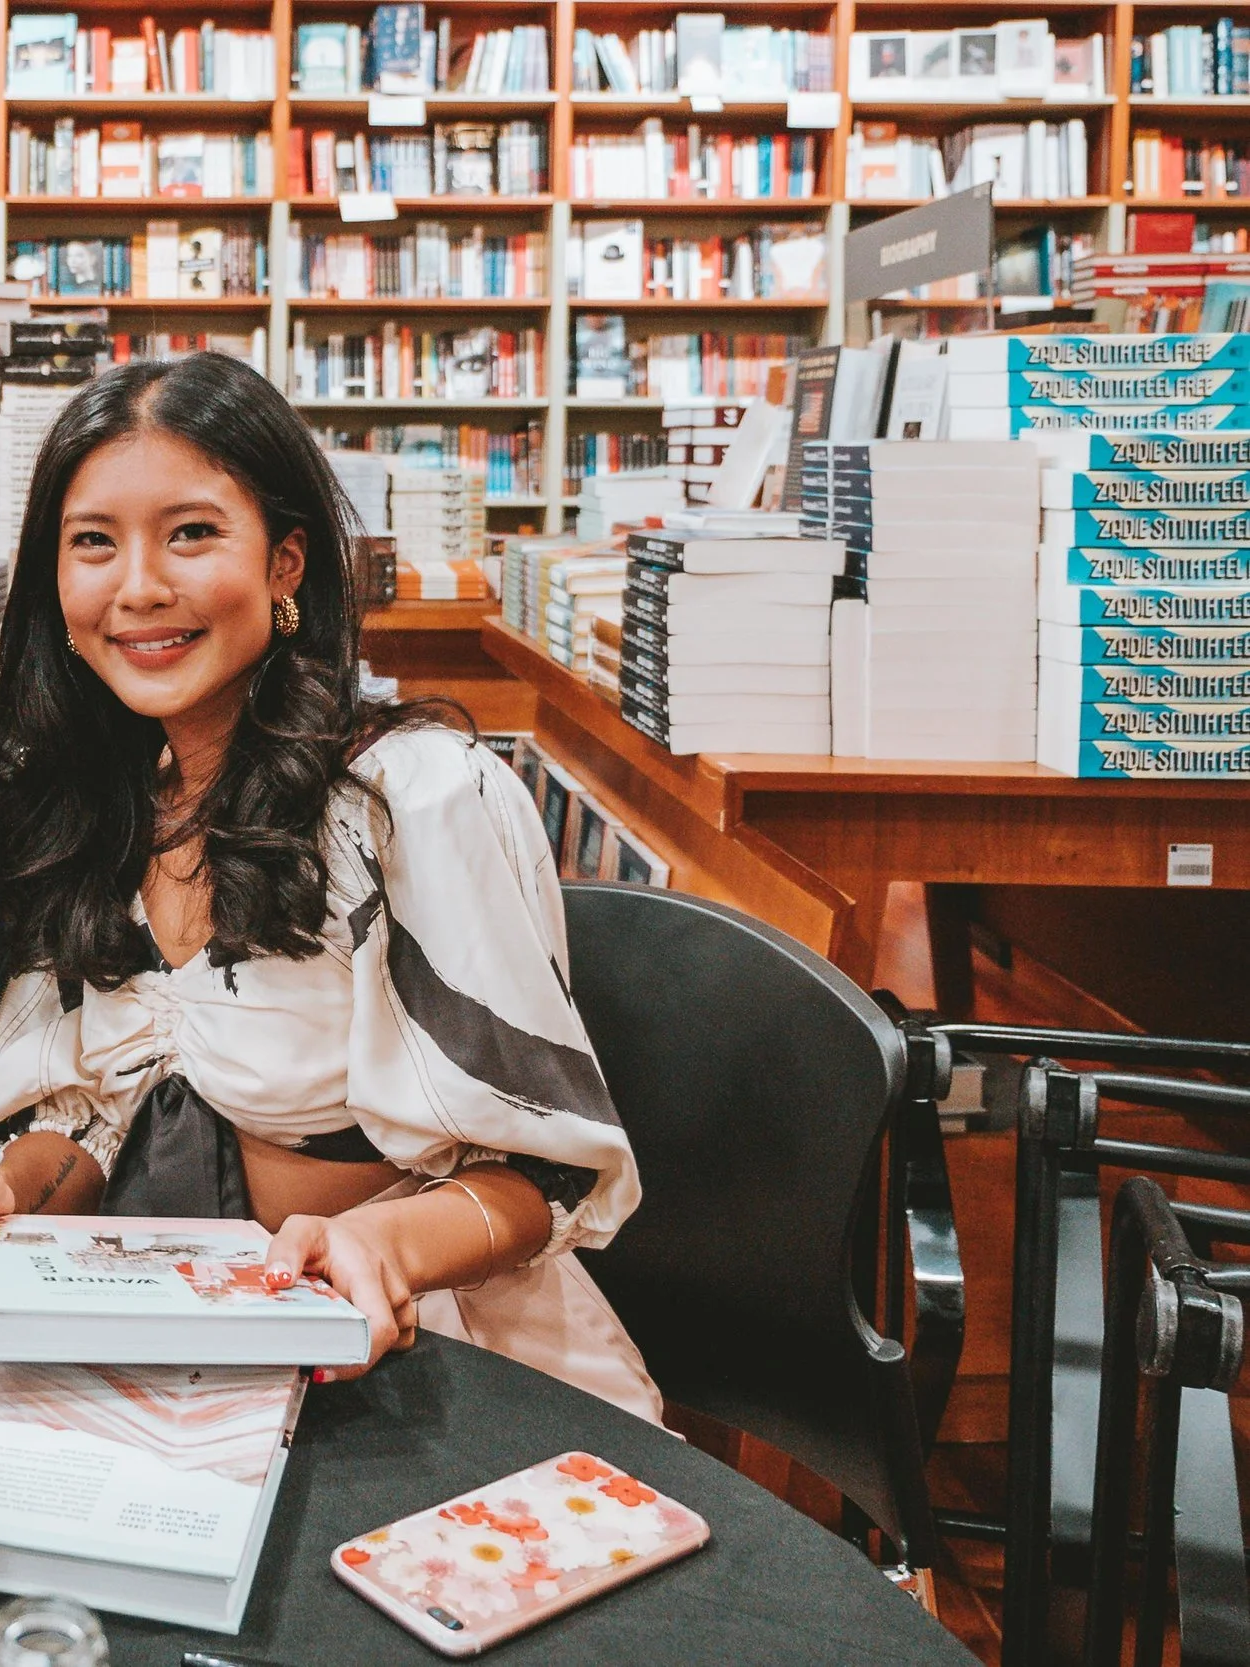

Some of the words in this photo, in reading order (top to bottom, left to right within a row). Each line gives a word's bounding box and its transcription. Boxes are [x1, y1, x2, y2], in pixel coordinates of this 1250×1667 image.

[880, 230, 938, 266] BIOGRAPHY
[1027, 343, 1075, 364] ZADIE
[1076, 342, 1131, 364] SMITH
[1134, 342, 1170, 364] FEEL
[1172, 342, 1212, 363] FREE
[1029, 378, 1077, 398] ZADIE
[1078, 377, 1133, 398] SMITH
[1136, 377, 1171, 398] FEEL
[1174, 377, 1213, 397] FREE
[1030, 414, 1077, 429] ZADIE
[1079, 413, 1134, 429] SMITH
[1137, 413, 1171, 429] FEEL
[1174, 413, 1214, 428] FREE
[1111, 441, 1162, 463] ZADIE
[1164, 440, 1223, 463] SMITH
[1093, 482, 1144, 503] ZADIE
[1147, 481, 1206, 503] SMITH
[1097, 519, 1148, 541] ZADIE
[1150, 518, 1210, 541] SMITH
[1089, 558, 1140, 579] ZADIE
[1142, 557, 1199, 579] SMITH
[1205, 557, 1242, 579] FEEL
[1102, 597, 1153, 619] ZADIE
[1156, 596, 1216, 619] SMITH
[1221, 596, 1250, 619] FEE
[1103, 636, 1156, 658] ZADIE
[1158, 635, 1218, 658] SMITH
[1223, 635, 1250, 658] FEE
[1102, 675, 1154, 697] ZADIE
[1157, 674, 1217, 697] SMITH
[1222, 674, 1250, 697] FEE
[1102, 713, 1154, 734] ZADIE
[1156, 712, 1214, 734] SMITH
[1221, 712, 1250, 734] FEE
[1101, 750, 1153, 771] ZADIE
[1155, 749, 1215, 771] SMITH
[1220, 749, 1250, 771] FEE
[42, 1275, 161, 1284] WANDER
